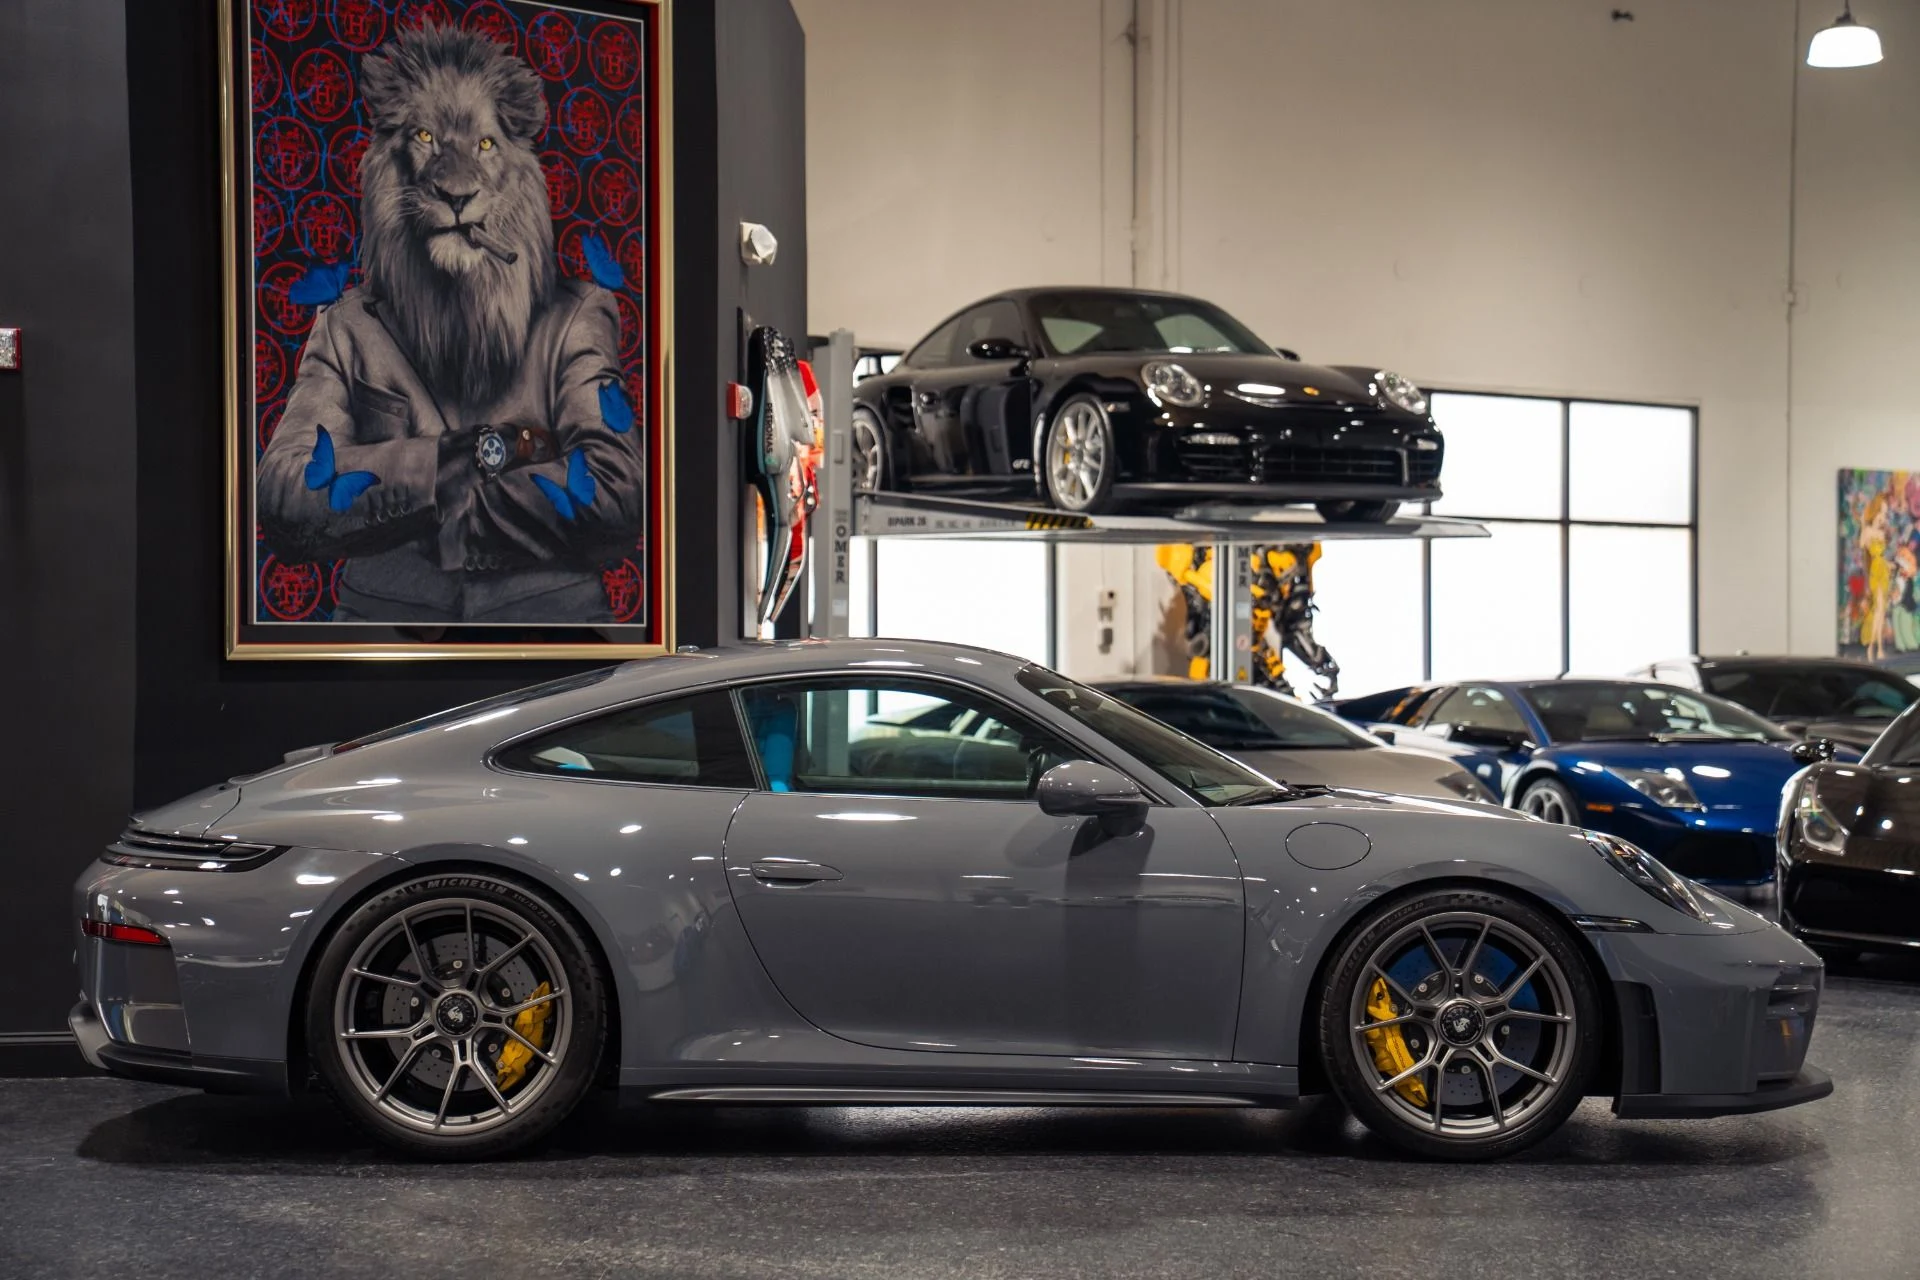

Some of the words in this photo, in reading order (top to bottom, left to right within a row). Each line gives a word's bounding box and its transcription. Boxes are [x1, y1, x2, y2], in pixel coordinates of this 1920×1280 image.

[765, 402, 774, 454] PETRONAS
[834, 524, 848, 584] OMER
[427, 878, 507, 896] MICHELIN
